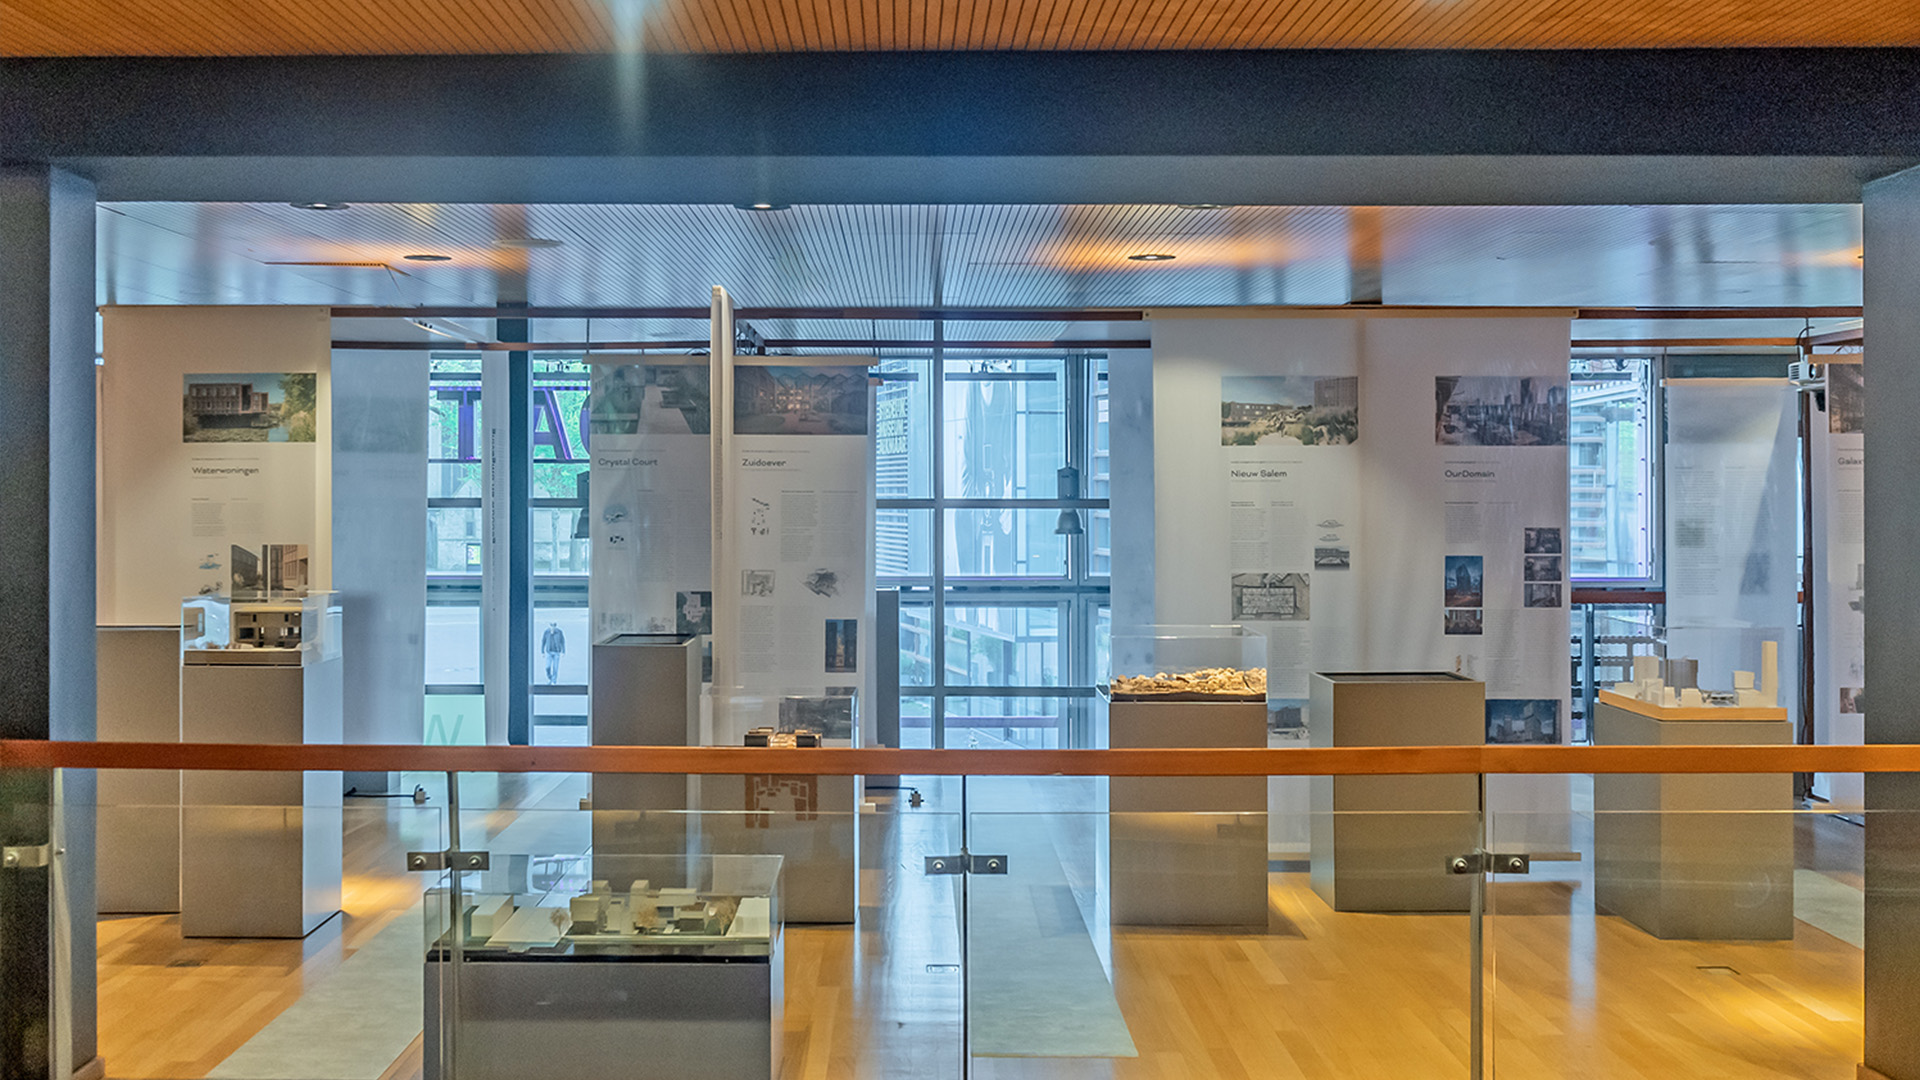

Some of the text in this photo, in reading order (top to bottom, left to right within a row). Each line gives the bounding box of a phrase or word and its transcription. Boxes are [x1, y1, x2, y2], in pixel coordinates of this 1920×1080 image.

[598, 457, 658, 467] Crystal Court
[742, 458, 787, 467] Zuidoever
[191, 467, 260, 477] Waterwoningen
[1230, 469, 1288, 478] Nieuw Salem
[1444, 469, 1496, 478] OurDomain
